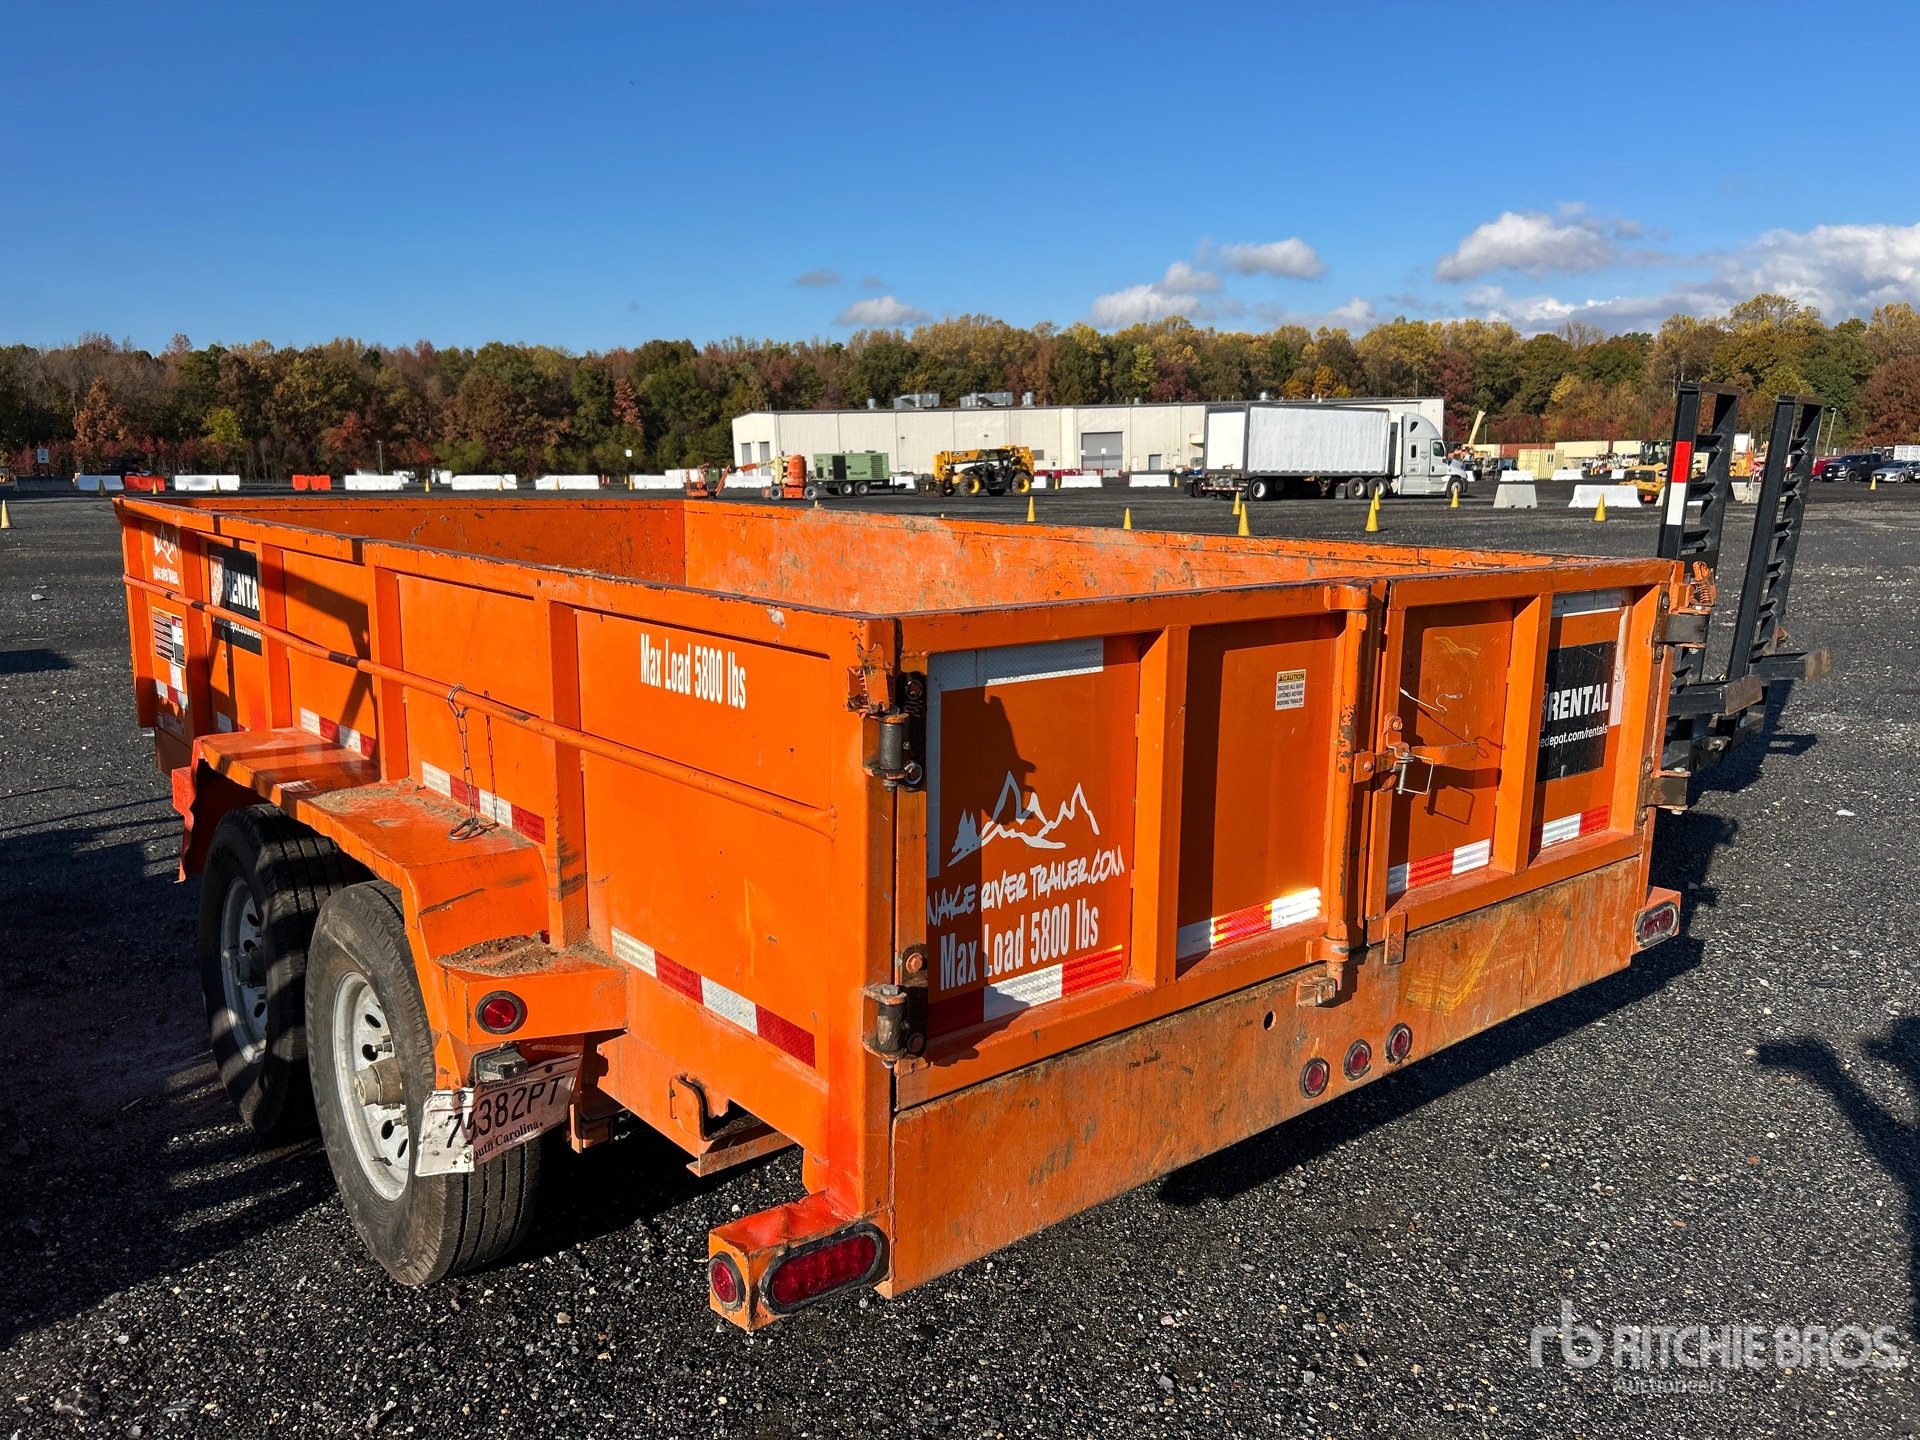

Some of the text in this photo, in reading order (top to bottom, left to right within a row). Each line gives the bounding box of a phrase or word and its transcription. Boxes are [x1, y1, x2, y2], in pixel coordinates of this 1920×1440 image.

[224, 569, 260, 611] RENTA
[640, 632, 747, 710] Max Load 5800 lbs
[1283, 673, 1304, 681] CAUTION
[1547, 682, 1609, 722] RENTAL
[1539, 723, 1608, 748] edepot.com/rentals
[927, 844, 1125, 926] NAKE RIVER TRAILER.COM
[940, 897, 1100, 991] Max Load 5800 lbs
[481, 1076, 528, 1092] Permanent
[446, 1075, 565, 1149] 75382PT
